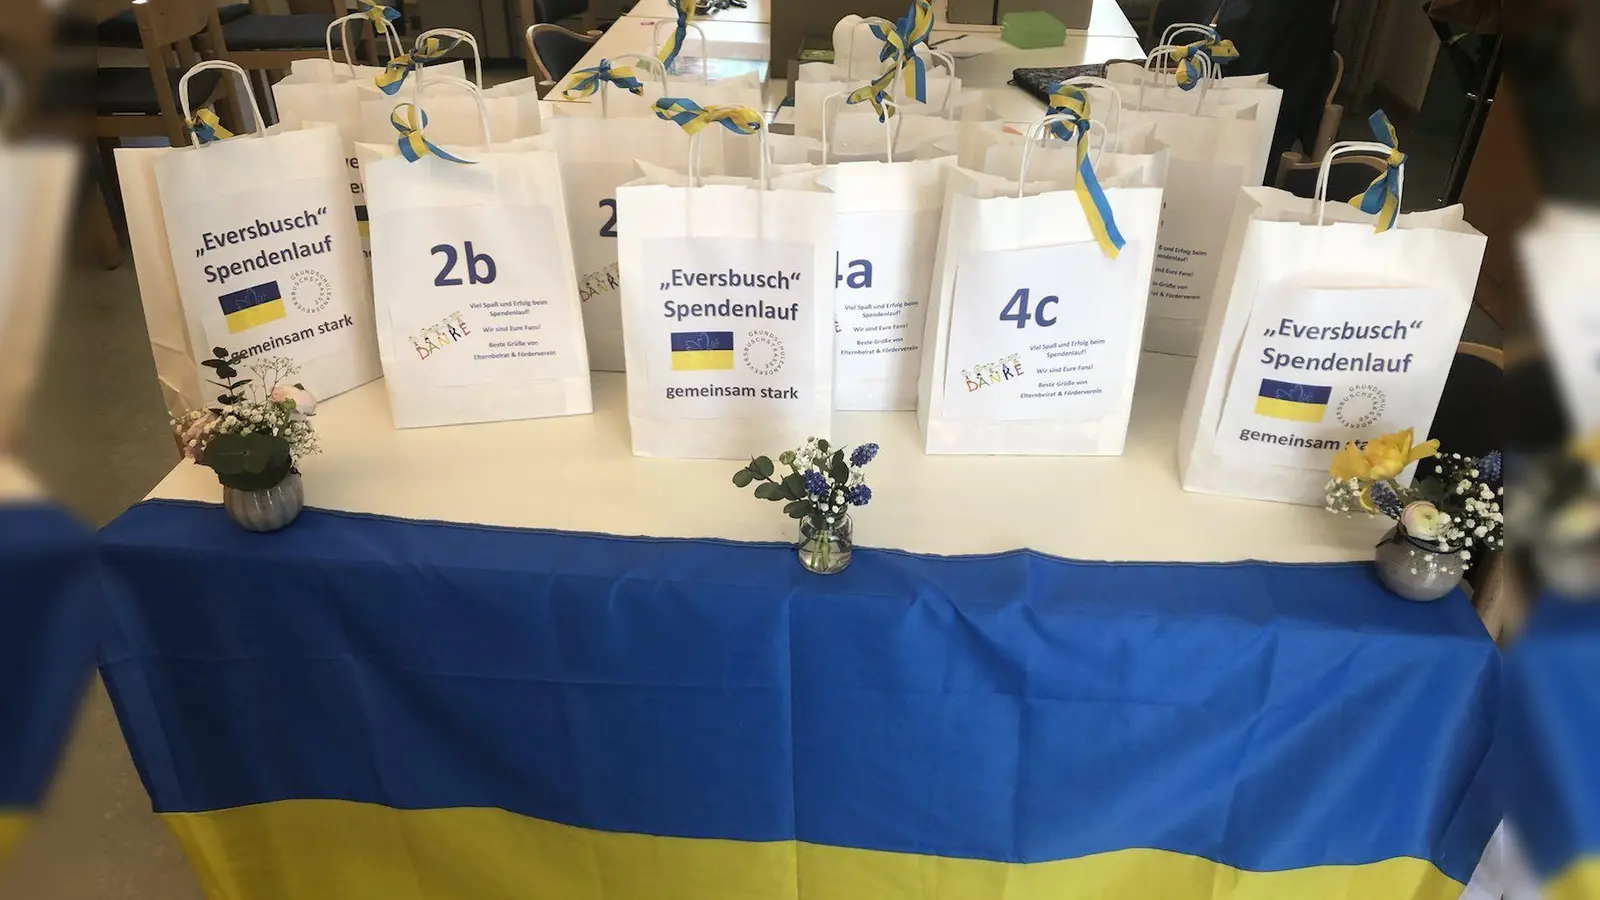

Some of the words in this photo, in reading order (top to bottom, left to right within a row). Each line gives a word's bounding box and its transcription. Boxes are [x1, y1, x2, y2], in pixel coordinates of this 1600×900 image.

[195, 206, 328, 258] „Eversbusch“
[204, 235, 333, 284] Spendenlauf
[430, 240, 497, 287] 2b
[659, 268, 801, 290] „Eversbusch“
[664, 299, 799, 321] Spendenlauf
[999, 288, 1060, 329] 4c
[231, 328, 315, 365] gemeinsam
[317, 314, 354, 335] stark
[1263, 317, 1423, 341] „Eversbusch“
[1260, 347, 1414, 373] Spendenlauf
[666, 384, 756, 400] gemeinsam
[760, 387, 799, 399] stark
[1239, 428, 1340, 451] gemeinsam
